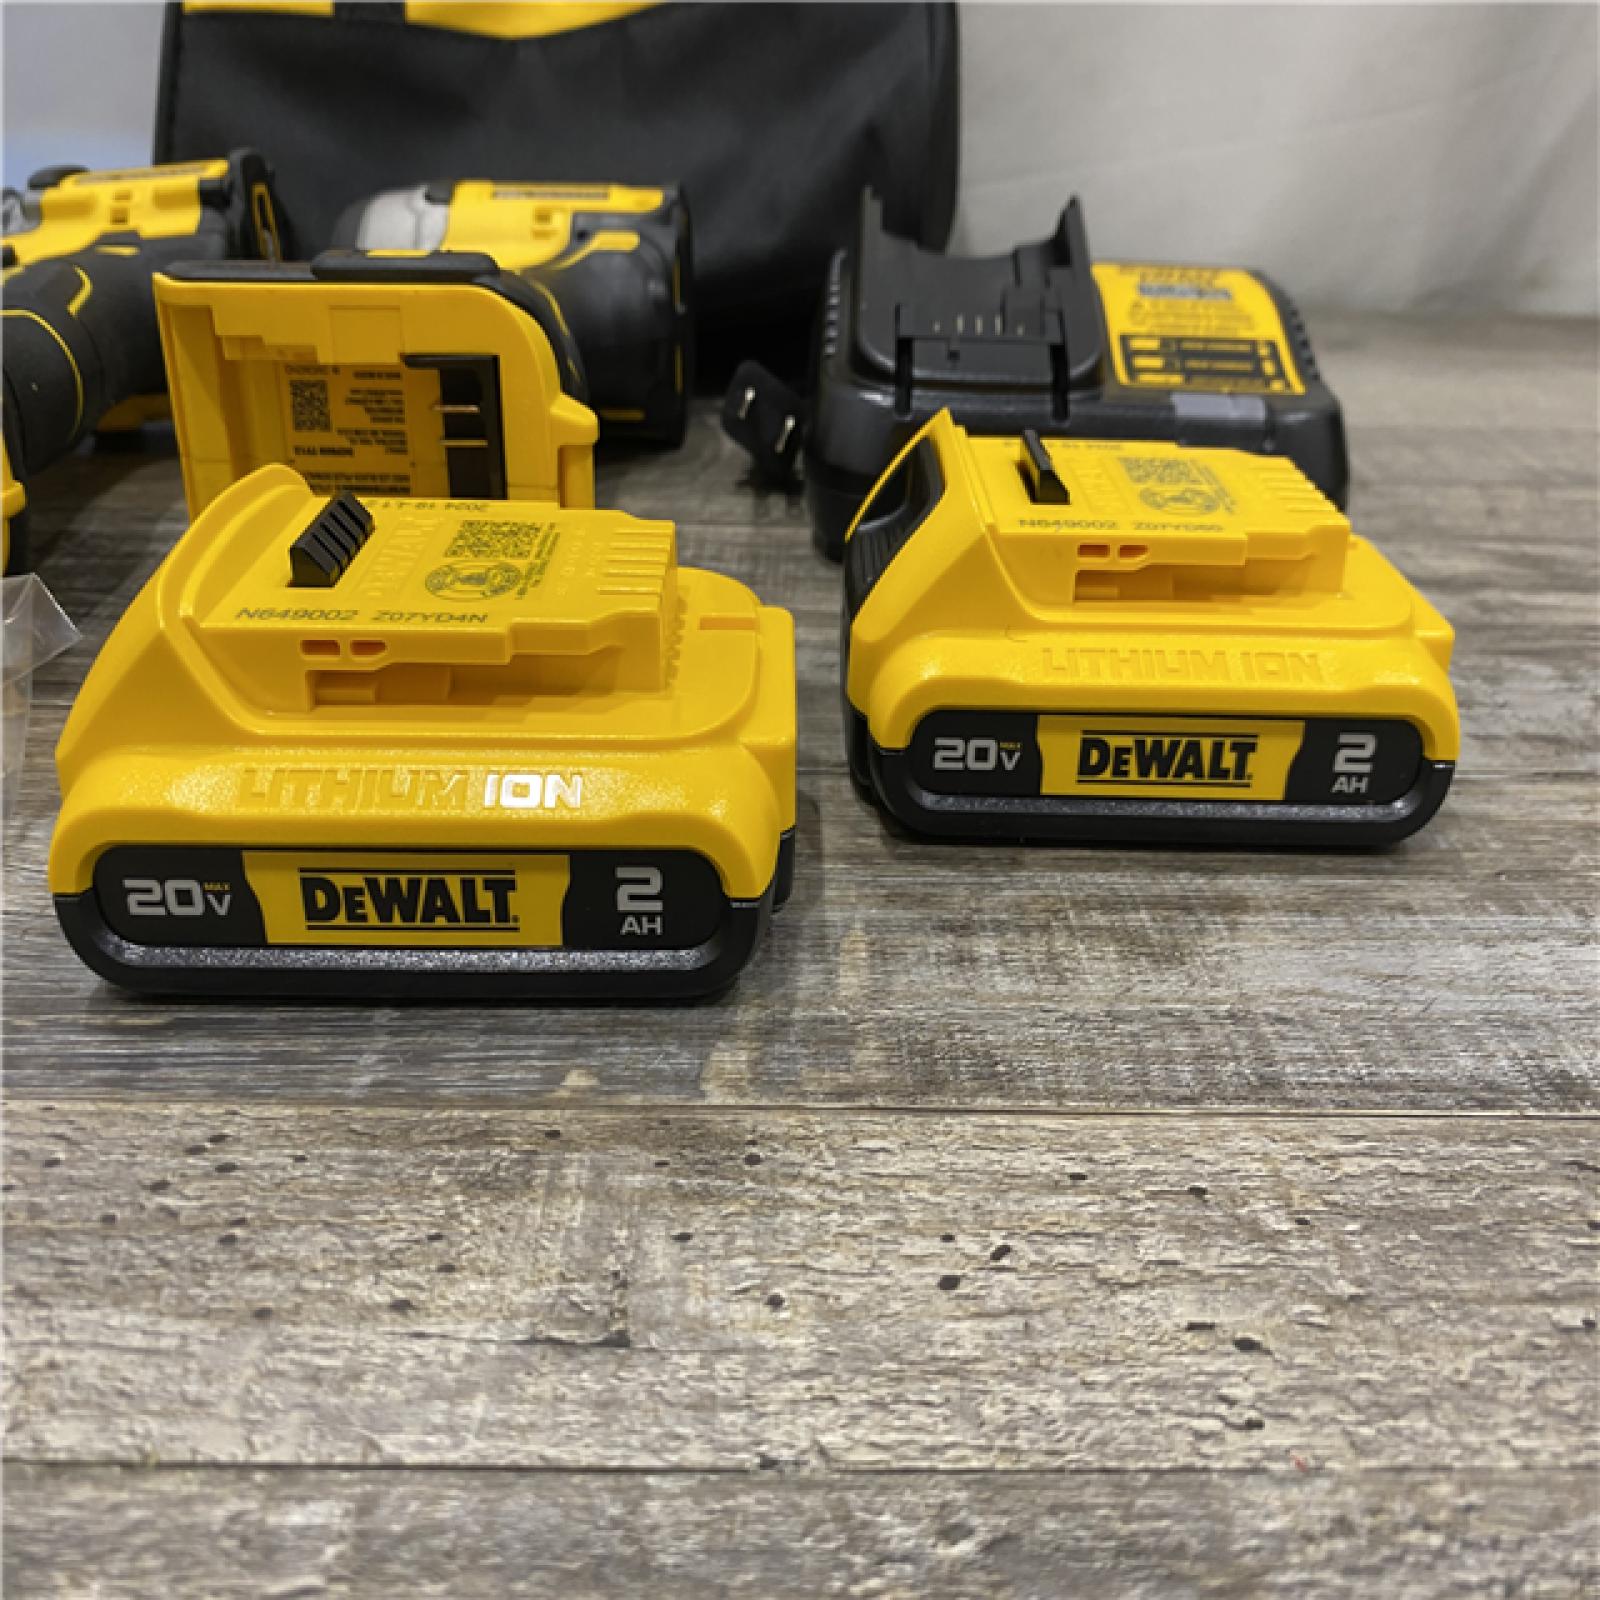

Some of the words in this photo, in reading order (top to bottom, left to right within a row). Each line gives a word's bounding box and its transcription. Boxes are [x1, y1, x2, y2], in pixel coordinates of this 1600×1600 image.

[1041, 647, 1230, 683] LITHIUM
[1239, 651, 1325, 684] ION
[1077, 736, 1257, 780] DEWALT
[1334, 733, 1376, 773] 2
[239, 767, 468, 809] LITHIUM
[484, 772, 583, 809] ION
[1331, 775, 1369, 793] AH
[300, 876, 519, 924] DEWALT
[615, 866, 663, 911] 2
[620, 915, 663, 936] AH
